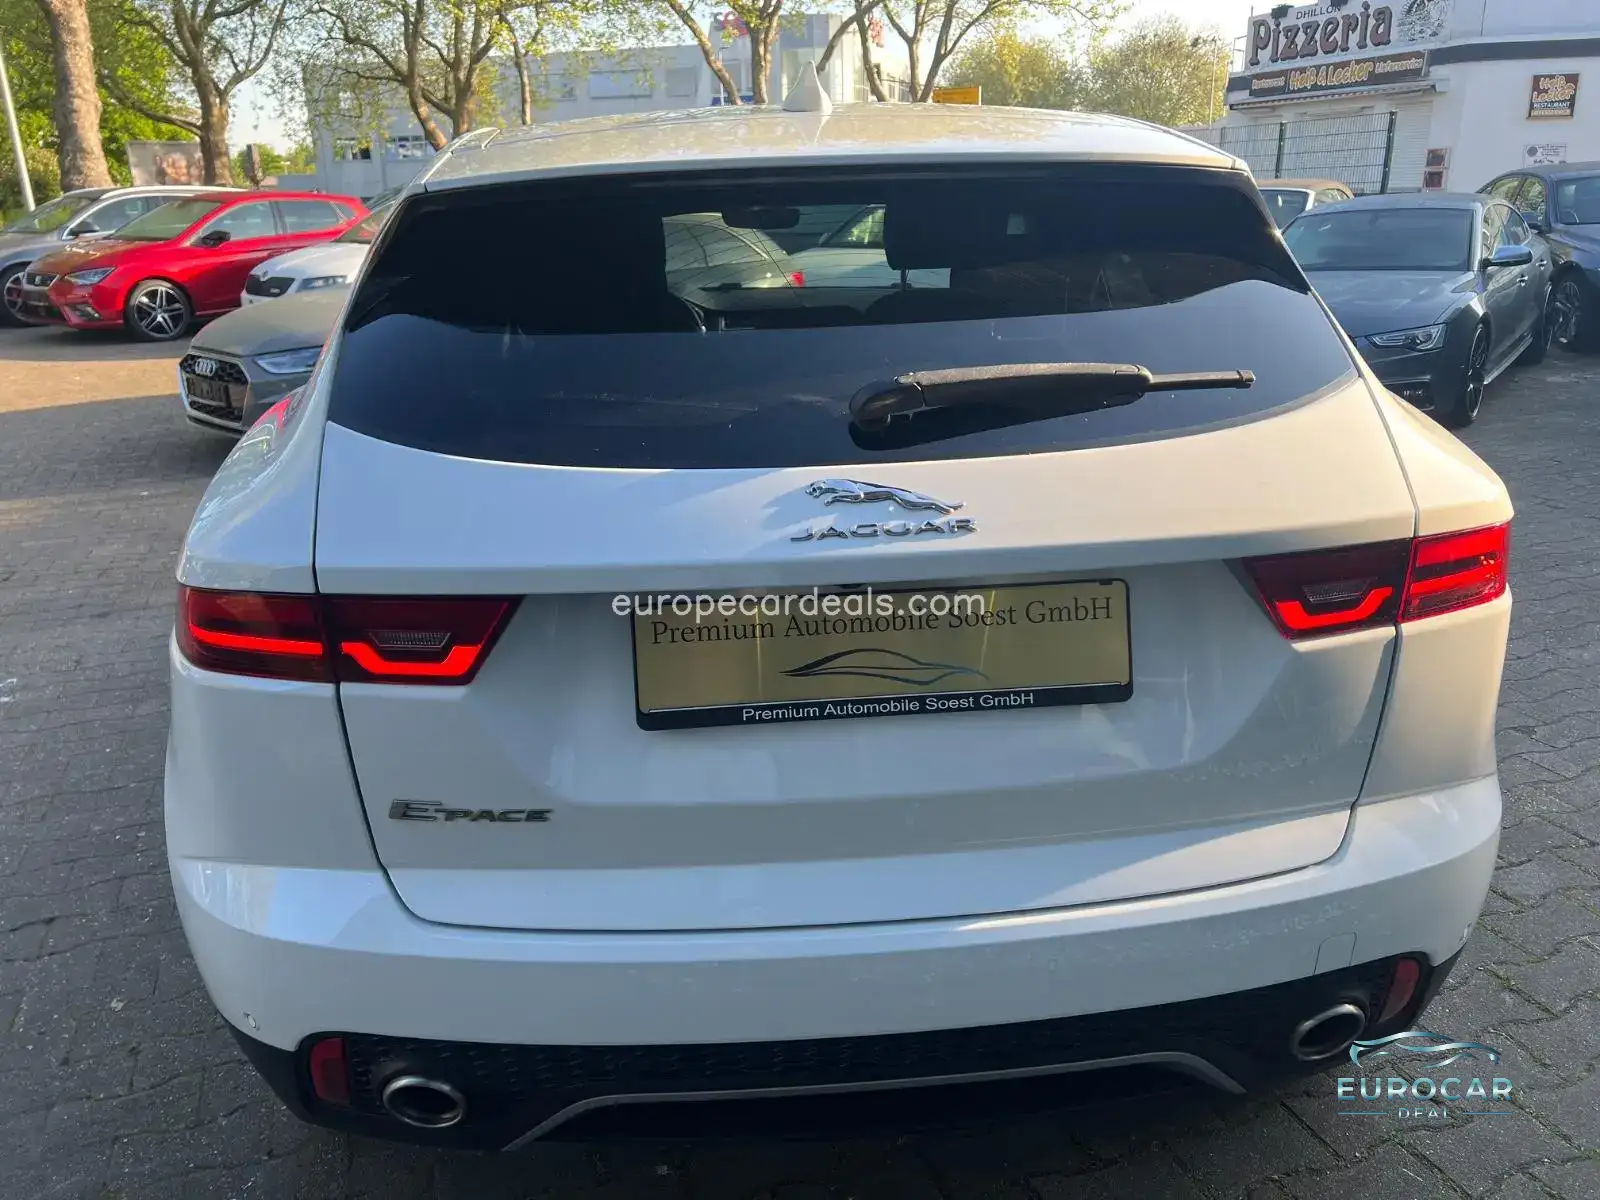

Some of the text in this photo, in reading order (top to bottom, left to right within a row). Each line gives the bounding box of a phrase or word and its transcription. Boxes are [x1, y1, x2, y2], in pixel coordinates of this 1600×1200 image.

[1295, 4, 1341, 20] DHILLON
[1250, 1, 1392, 66] Pizzeria
[1533, 101, 1571, 109] RESTAURANT
[790, 519, 979, 543] JAGUAR
[651, 596, 1113, 645] Premium Automobile Soest GmbH
[742, 692, 1035, 721] Premium Automobile Soest GmbH
